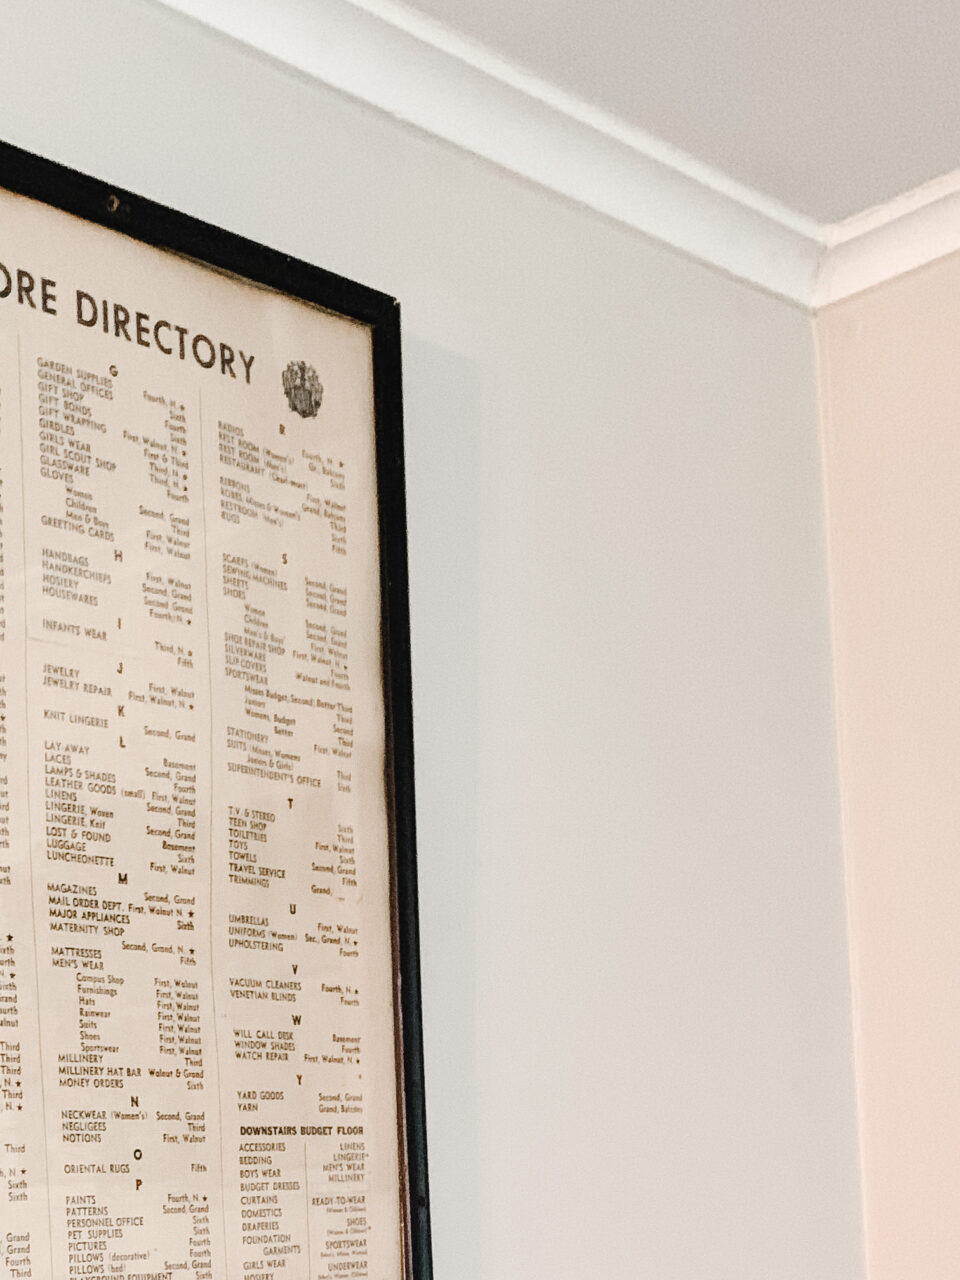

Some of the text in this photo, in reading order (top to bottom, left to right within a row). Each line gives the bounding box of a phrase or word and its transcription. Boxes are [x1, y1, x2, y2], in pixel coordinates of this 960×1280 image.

[76, 289, 254, 383] DIRECTORY
[108, 364, 118, 377] G
[40, 466, 73, 483] GLOVES
[119, 735, 126, 748] L
[44, 752, 71, 765] LACES
[44, 776, 116, 795] LEATHER GOODS
[45, 789, 77, 802] LINENS
[287, 797, 293, 809] T
[46, 838, 86, 852] LUGGAGE
[228, 838, 247, 850] TOYS
[46, 849, 114, 867] LUNCHEONETTE
[228, 850, 256, 863] TOWELS
[228, 862, 285, 878] TRAVEL SERVICE
[46, 882, 97, 896] MAGAZINES
[289, 903, 296, 915] U
[48, 907, 130, 924] MAJOR APPLIANCES
[228, 913, 269, 926] UMBRELLAS
[228, 938, 283, 951] UPHOLSTERING
[50, 946, 102, 959] MATTRESSES
[291, 963, 298, 975] V
[228, 977, 301, 991] VACUUM CLEANERS
[291, 1014, 301, 1025] W
[233, 1029, 293, 1040] WILL CALL DESK
[0, 1040, 20, 1051] Third
[233, 1040, 295, 1051] WINDOW SHADES
[57, 1053, 103, 1063] MILLINERY
[234, 1050, 288, 1061] WATCH REPAIR
[58, 1065, 141, 1076] MILLINERY HAT BAR
[295, 1074, 302, 1085] Y
[236, 1090, 284, 1100] YARD GOODS
[61, 1109, 106, 1119] NECKWEAR
[61, 1121, 106, 1131] NEGLIGEES
[239, 1125, 363, 1136] DOWNSTAIRS BUDGET FLOOR
[62, 1132, 101, 1143] NOTIONS
[3, 1143, 25, 1153] Third
[238, 1142, 286, 1152] ACCESSORIES
[132, 1148, 142, 1160] O
[63, 1163, 207, 1174] ORIENTAL RUGS Fifth
[239, 1168, 281, 1178] BOYS WEAR
[7, 1179, 27, 1189] Sixth
[135, 1178, 142, 1191] P
[65, 1194, 95, 1204] PAINTS
[240, 1194, 277, 1205] CURTAINS
[65, 1205, 108, 1216] PATTERNS
[241, 1207, 282, 1218] DOMESTICS
[66, 1216, 143, 1227] PERSONNEL OFFICE
[67, 1228, 123, 1240] PET SUPPLIES
[242, 1233, 290, 1244] FOUNDATION
[68, 1240, 107, 1251] PICTURES
